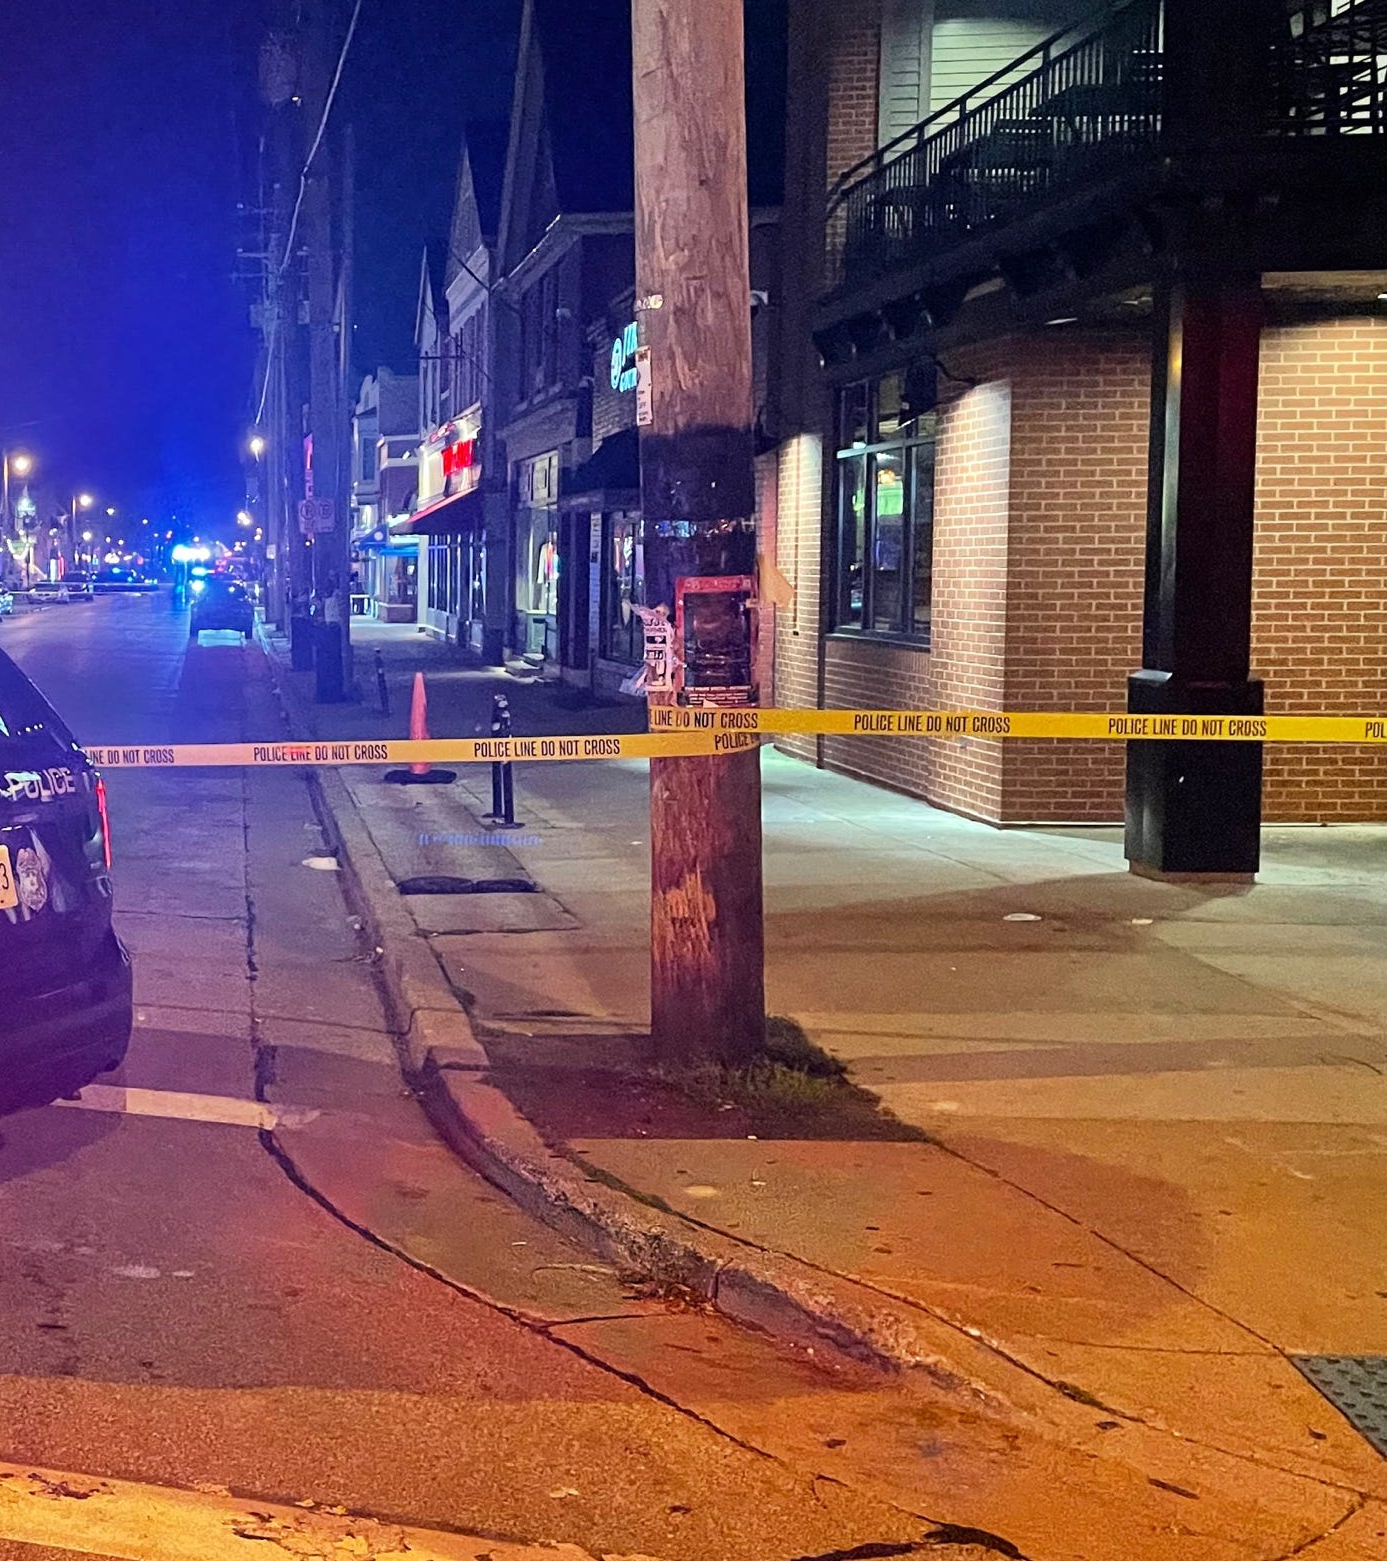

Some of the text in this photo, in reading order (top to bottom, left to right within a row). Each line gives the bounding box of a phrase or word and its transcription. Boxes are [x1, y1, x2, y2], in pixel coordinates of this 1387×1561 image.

[654, 710, 672, 726] LINE
[675, 711, 690, 727] DO
[694, 711, 717, 727] NOT
[720, 711, 758, 728] CROSS
[854, 714, 1010, 733] POLICE LINE DO NOT CROSS
[1108, 718, 1267, 737] POLICE LINE DO NOT CROSS
[474, 739, 620, 757] POLICE LINE DO NOT CROSS
[714, 731, 749, 750] POLICE
[85, 748, 175, 765] INE DO NOT CROSS
[253, 744, 388, 762] POLICE LINE DO NOT CROSS
[4, 767, 75, 802] POLICE
